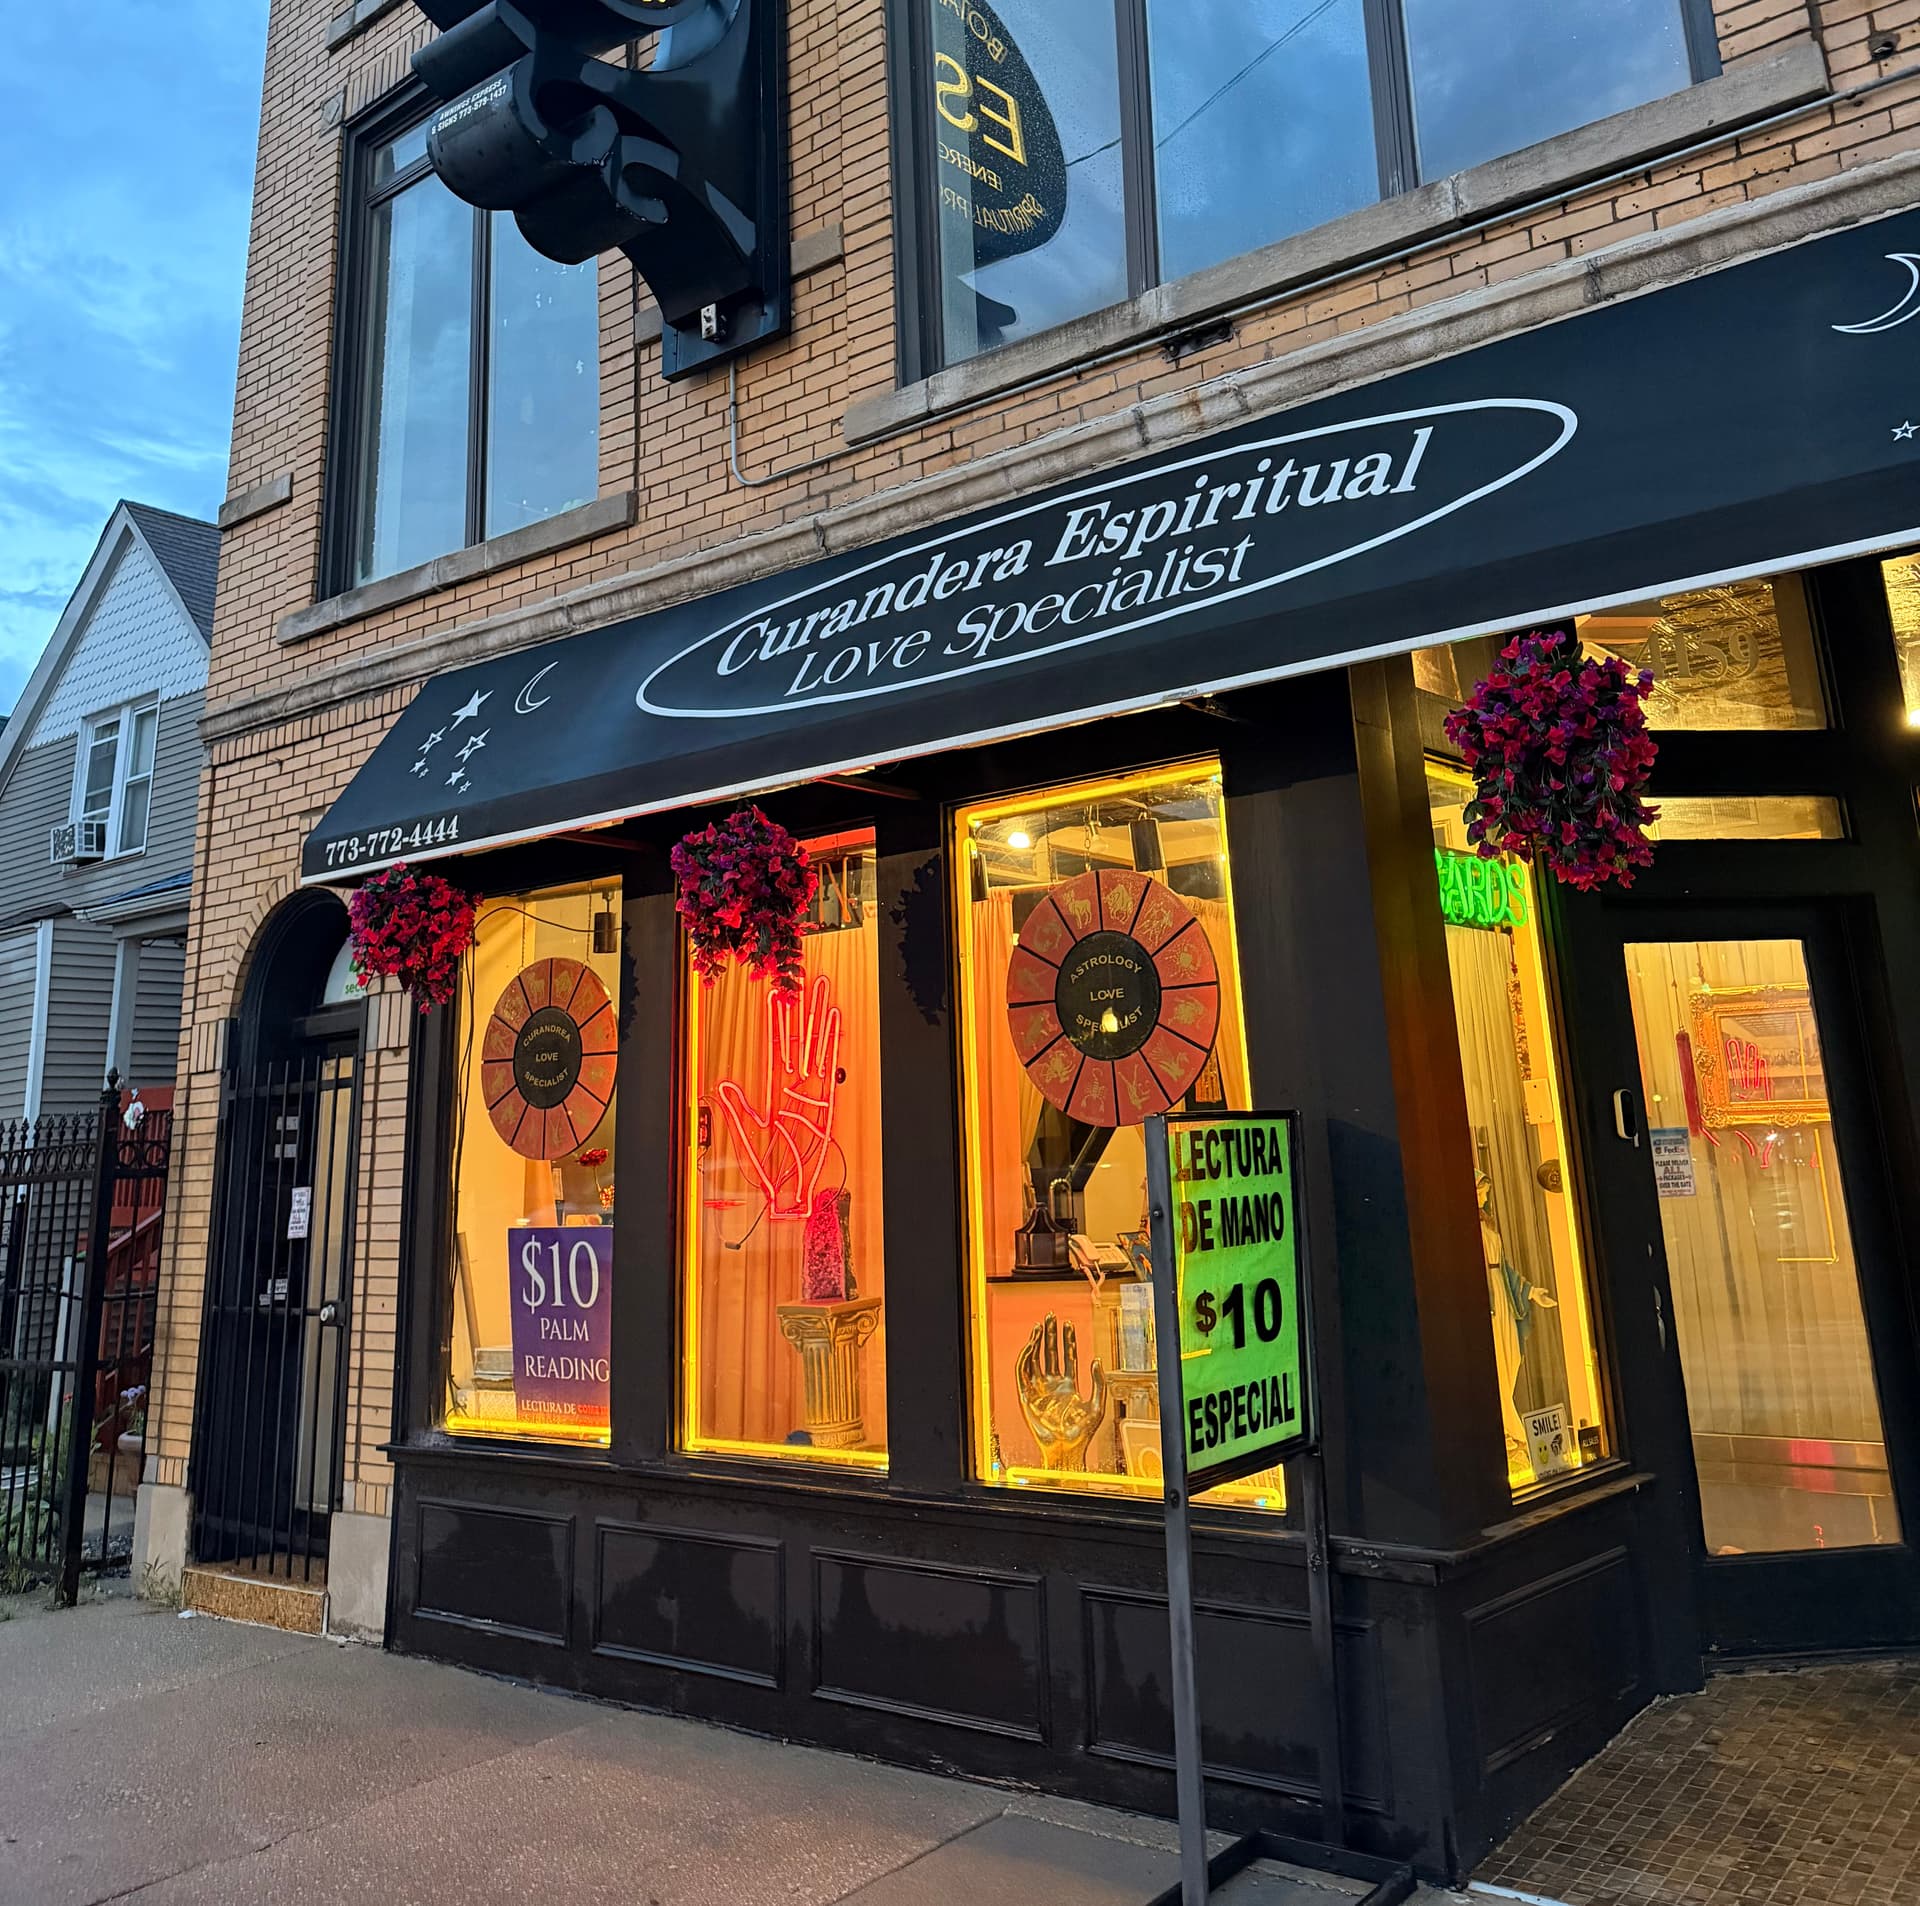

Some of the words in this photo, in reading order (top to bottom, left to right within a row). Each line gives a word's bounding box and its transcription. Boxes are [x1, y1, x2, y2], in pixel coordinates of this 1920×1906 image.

[716, 539, 1032, 676] Curandera
[1044, 426, 1434, 566] Espiritual
[784, 630, 932, 696] Love
[943, 533, 1255, 658] Specialist
[1632, 631, 1759, 679] 4159
[326, 815, 459, 866] 773-772-4444
[1070, 954, 1142, 984] ASTROLOGY
[1090, 988, 1125, 1001] LOVE
[524, 1067, 569, 1087] SPECIALIST
[535, 1052, 559, 1062] LOVE
[1176, 1127, 1283, 1182] LECTURA
[1181, 1199, 1215, 1253] DE
[1221, 1192, 1284, 1248] MANO
[521, 1235, 599, 1314] $10
[540, 1317, 590, 1342] PALM
[1196, 1278, 1283, 1350] $10
[525, 1355, 610, 1382] READING
[521, 1400, 562, 1414] LECTURA
[564, 1402, 577, 1415] DE
[1189, 1372, 1294, 1454] ESPECIAL
[1532, 1413, 1562, 1436] SMILE!
